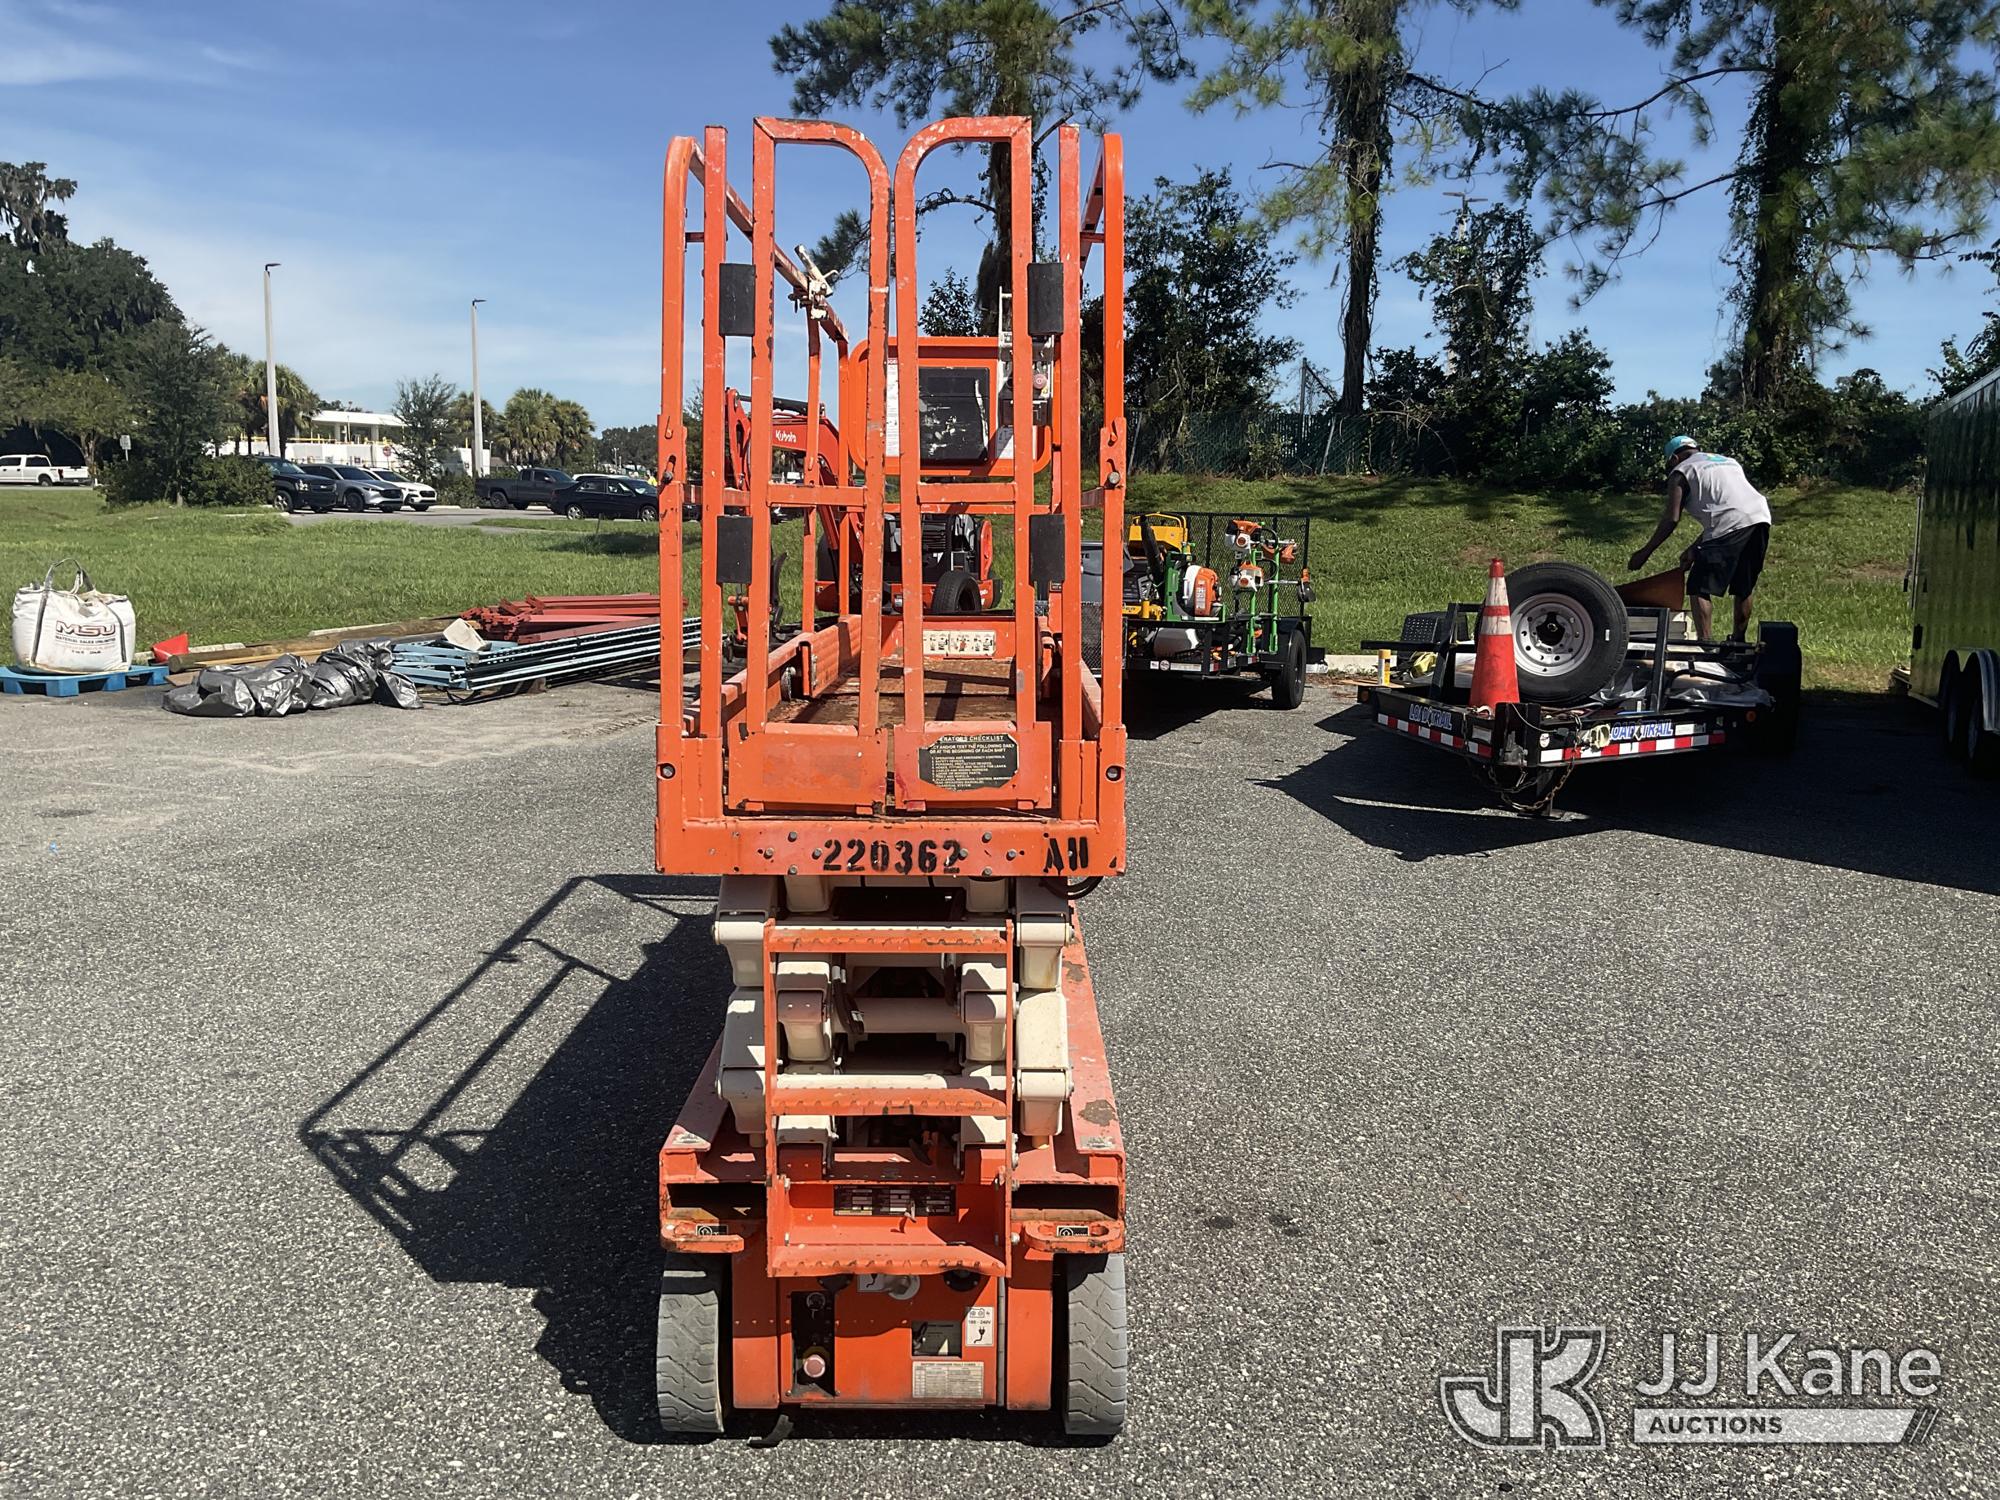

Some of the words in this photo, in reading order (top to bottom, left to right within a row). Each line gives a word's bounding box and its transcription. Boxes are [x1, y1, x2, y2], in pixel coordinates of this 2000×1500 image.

[56, 621, 115, 636] MSU
[1609, 721, 1637, 741] OAD
[1640, 719, 1674, 738] TRAIL
[823, 839, 961, 875] 220362
